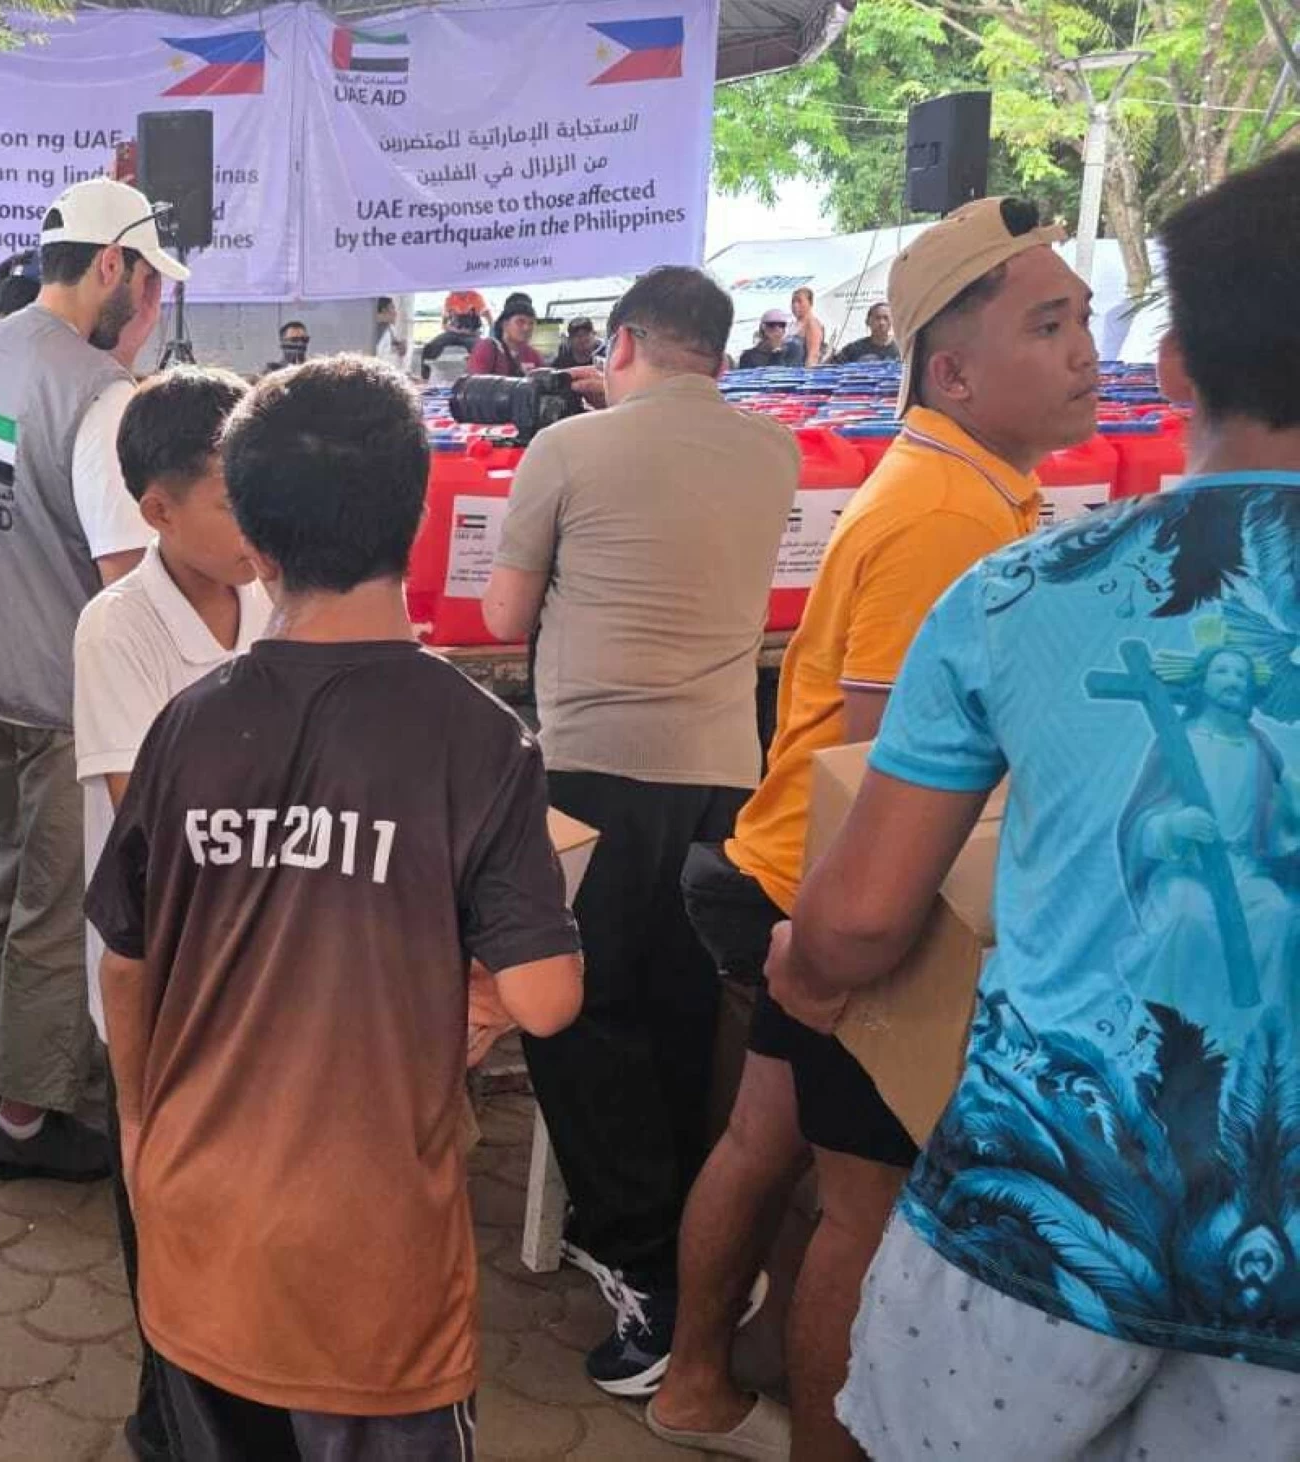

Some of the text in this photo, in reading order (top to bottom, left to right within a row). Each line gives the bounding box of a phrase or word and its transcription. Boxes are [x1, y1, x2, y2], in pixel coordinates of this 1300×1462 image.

[334, 84, 407, 106] UAE AID
[557, 113, 639, 140] الاستجابة
[37, 132, 65, 152] ng
[74, 130, 122, 149] UAE
[27, 167, 55, 187] ng
[417, 154, 607, 188] من الزلزال في الفلبين
[357, 180, 656, 223] UAE response to those affected
[335, 206, 686, 252] by the earthquake in the Philippines
[465, 259, 490, 272] June
